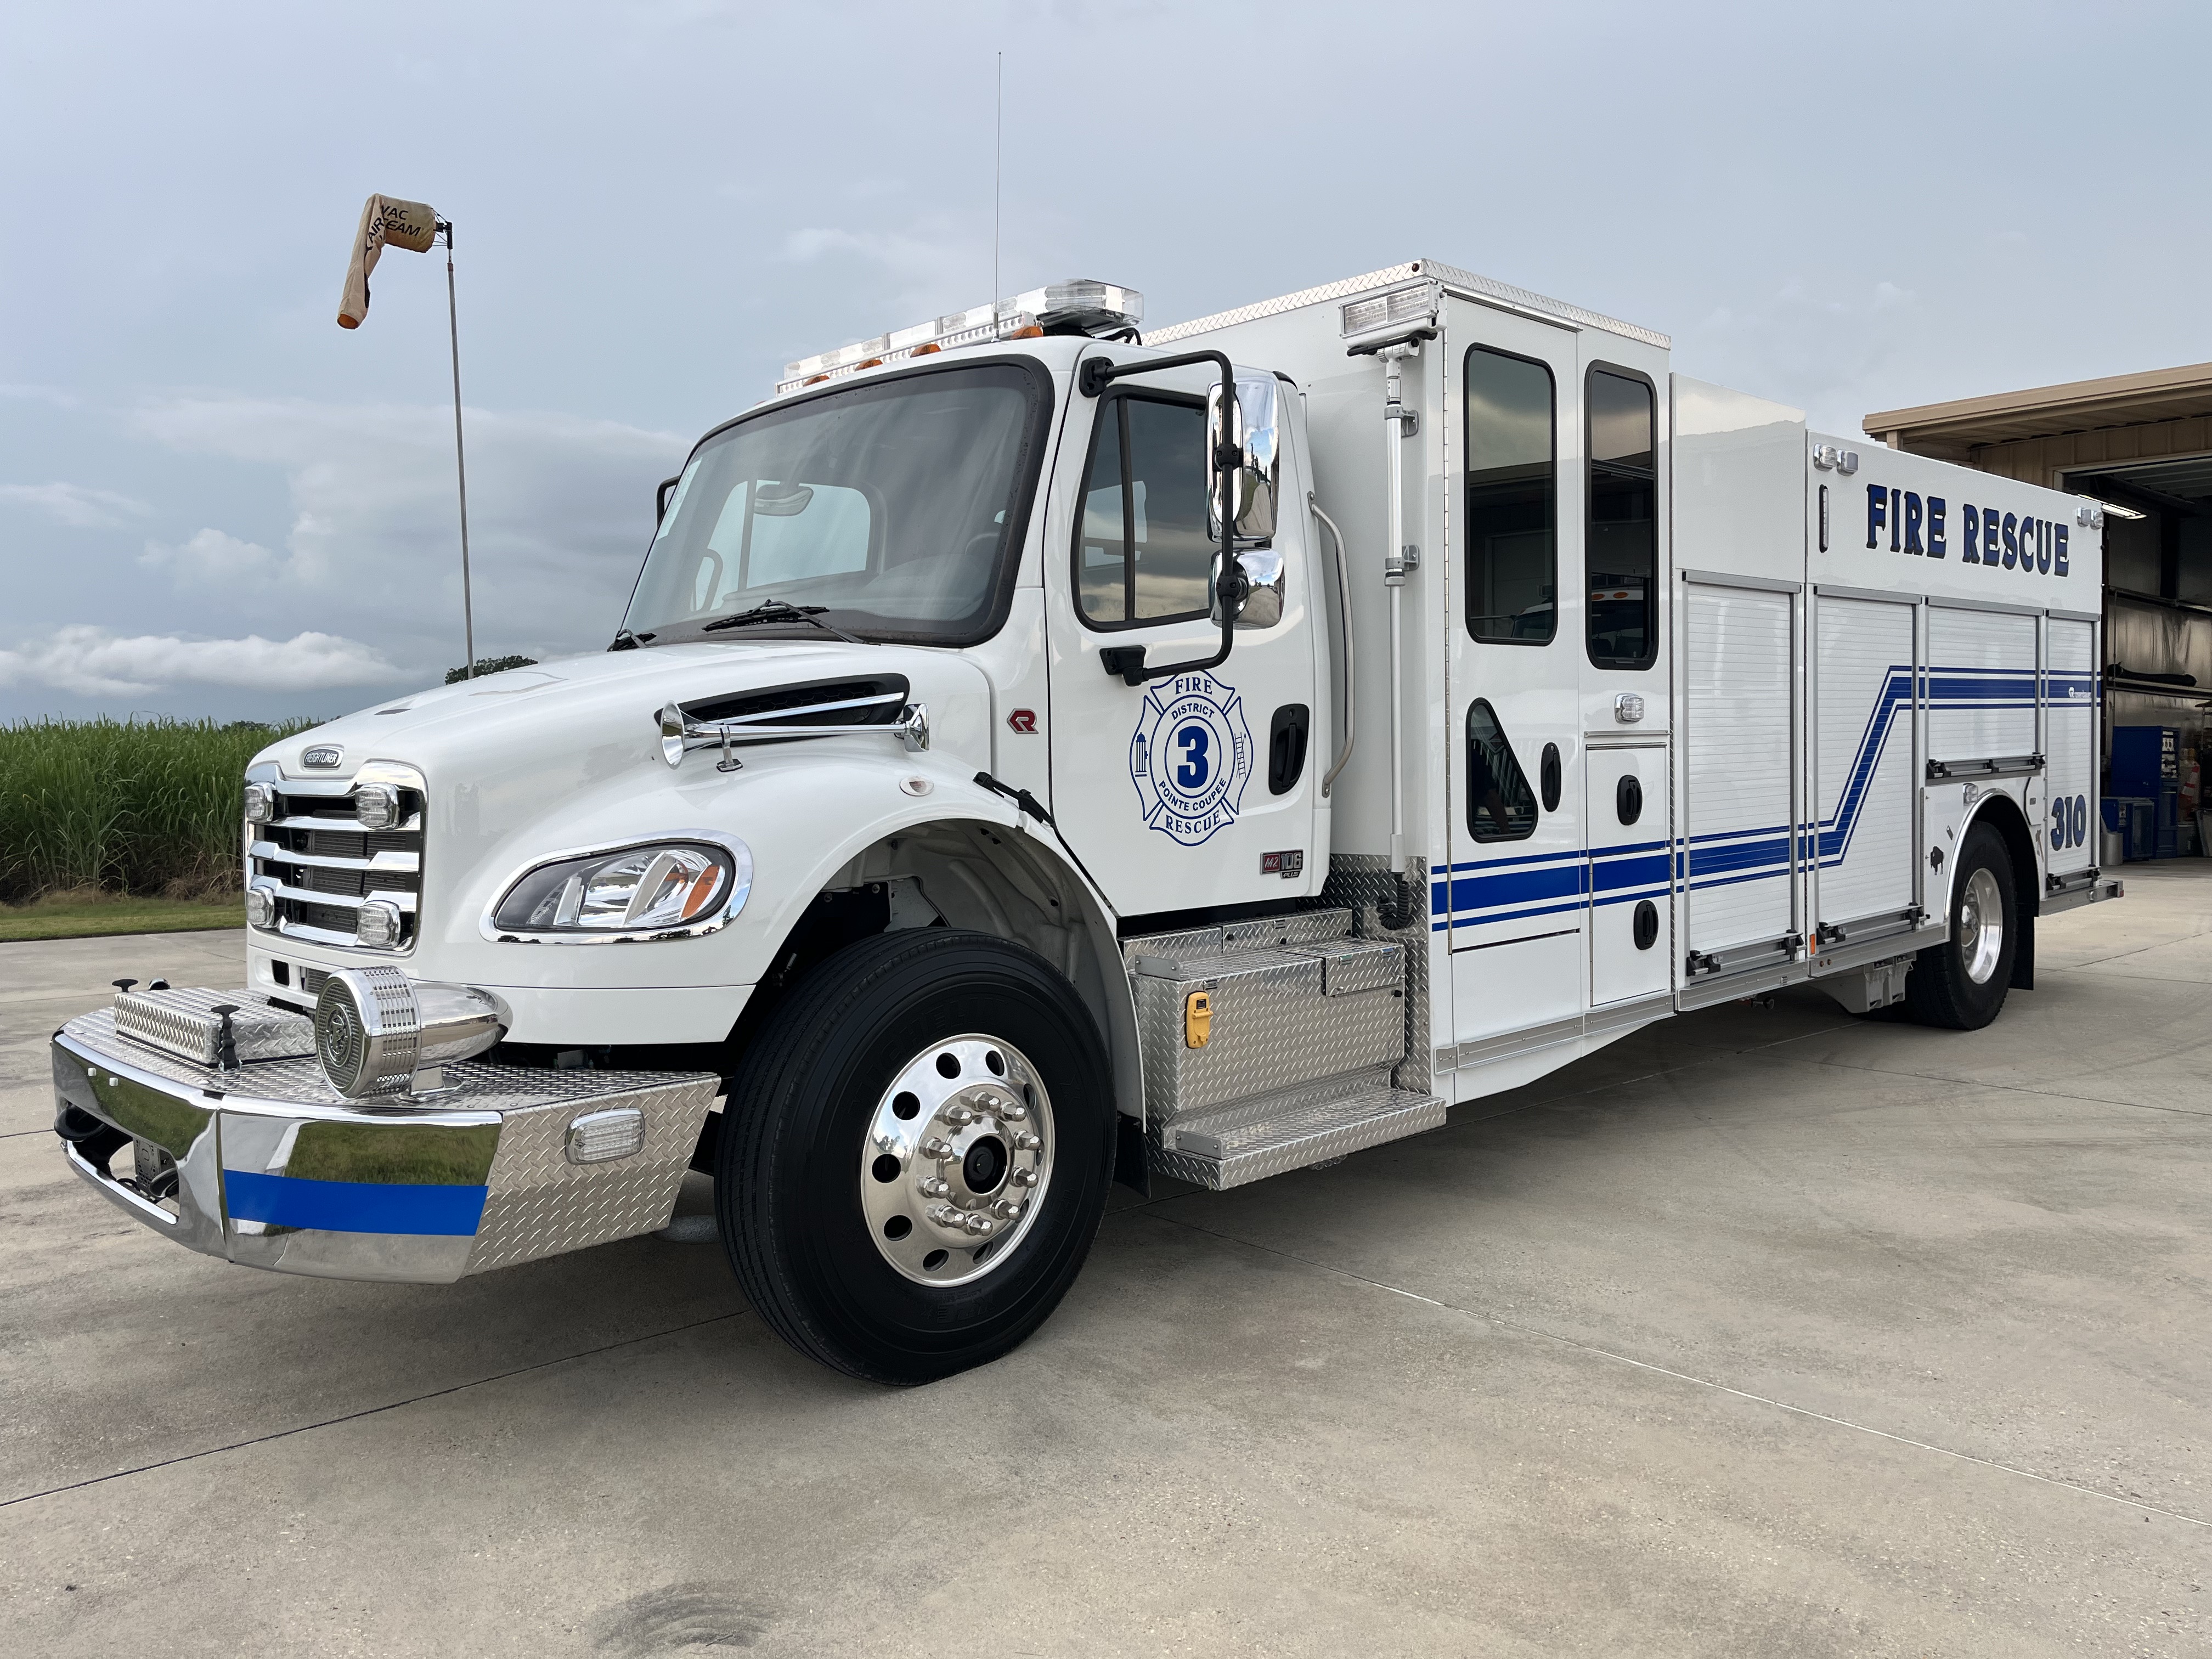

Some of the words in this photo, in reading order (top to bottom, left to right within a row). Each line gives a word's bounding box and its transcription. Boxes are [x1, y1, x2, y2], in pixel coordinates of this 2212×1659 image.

[1866, 483, 1946, 559] FIRE
[1962, 503, 2069, 577] RESCUE
[1175, 677, 1213, 695] FIRE
[1171, 703, 1215, 720] DISTRICT
[305, 752, 338, 763] FREIGHTLINER
[1177, 726, 1209, 789] 3
[1159, 780, 1189, 811] POINTE
[1193, 778, 1226, 811] COUPEE
[1165, 810, 1221, 834] RESCUE
[2051, 794, 2086, 851] 310
[1265, 856, 1279, 868] M2
[1280, 852, 1302, 870] 106
